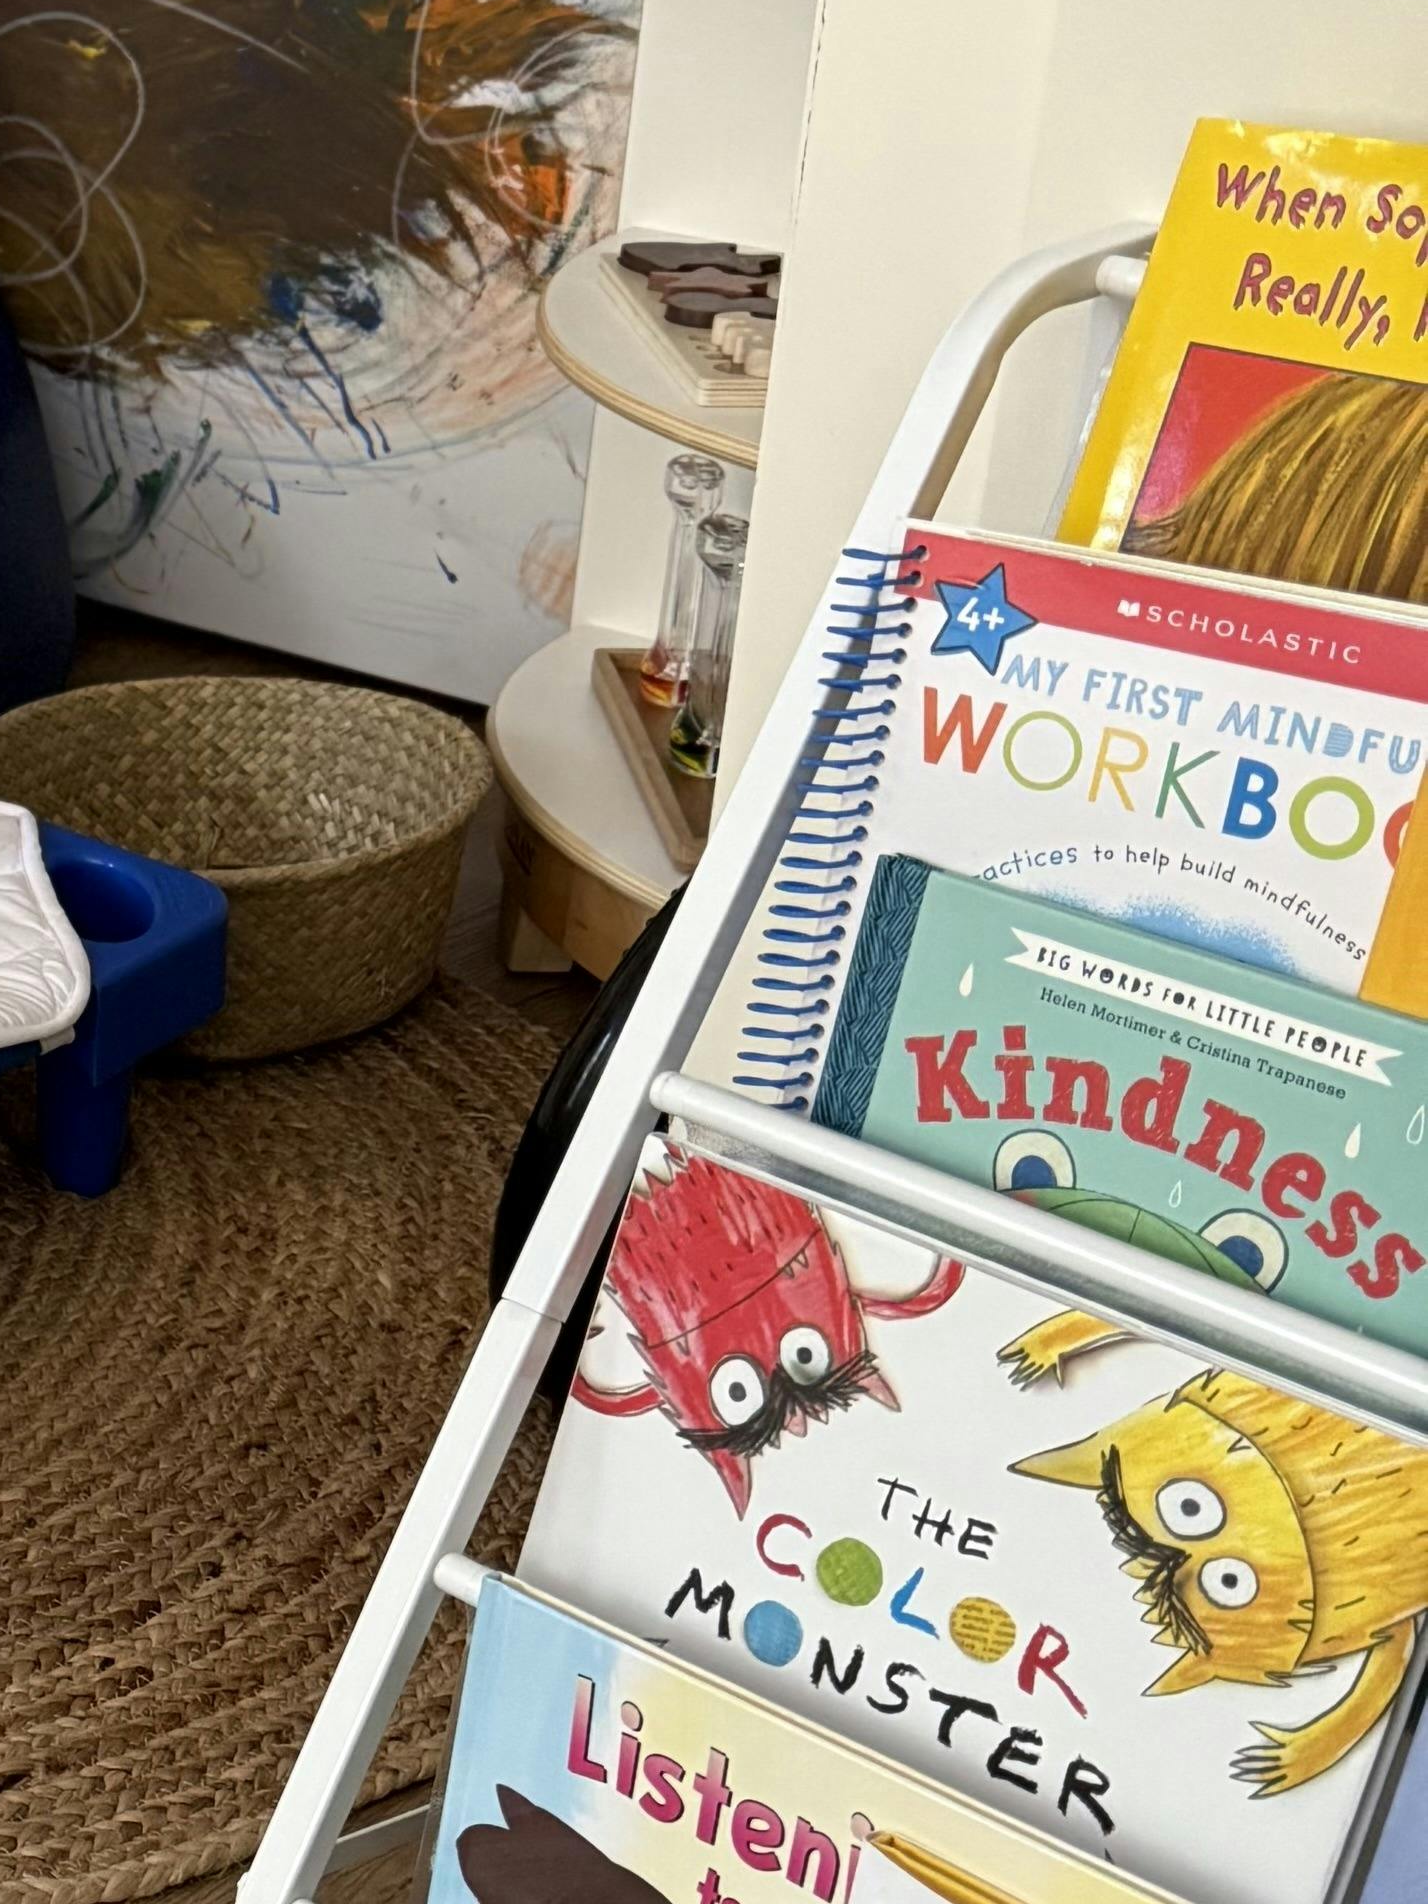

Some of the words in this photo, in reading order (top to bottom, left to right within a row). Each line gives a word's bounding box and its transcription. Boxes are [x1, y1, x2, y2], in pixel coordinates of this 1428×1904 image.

[1215, 162, 1346, 230] When
[1233, 252, 1391, 351] Really,
[956, 597, 1006, 633] 4+
[1146, 606, 1362, 664] SCHOLASTIC
[1000, 653, 1071, 698] MY
[1083, 667, 1204, 727] FIRST
[1093, 844, 1115, 863] to
[1125, 844, 1170, 876] help
[1180, 853, 1236, 884] build
[1243, 876, 1367, 962] mindfulness
[1037, 947, 1071, 971] BIG
[1082, 960, 1153, 998] WORDS
[1162, 987, 1197, 1011] FOR
[1205, 1000, 1276, 1038] LITTLE
[1285, 1027, 1368, 1069] PEOPLE
[1040, 987, 1087, 1012] Helen
[1090, 1002, 1168, 1041] Mortimer
[1169, 1030, 1183, 1046] &
[1186, 1035, 1251, 1070] Cristina
[1256, 1057, 1347, 1100] Trapanese
[904, 1024, 1428, 1300] Kindness
[877, 1477, 1000, 1560] THE
[755, 1512, 1089, 1720] COLOR
[663, 1566, 1116, 1837] MONSTER
